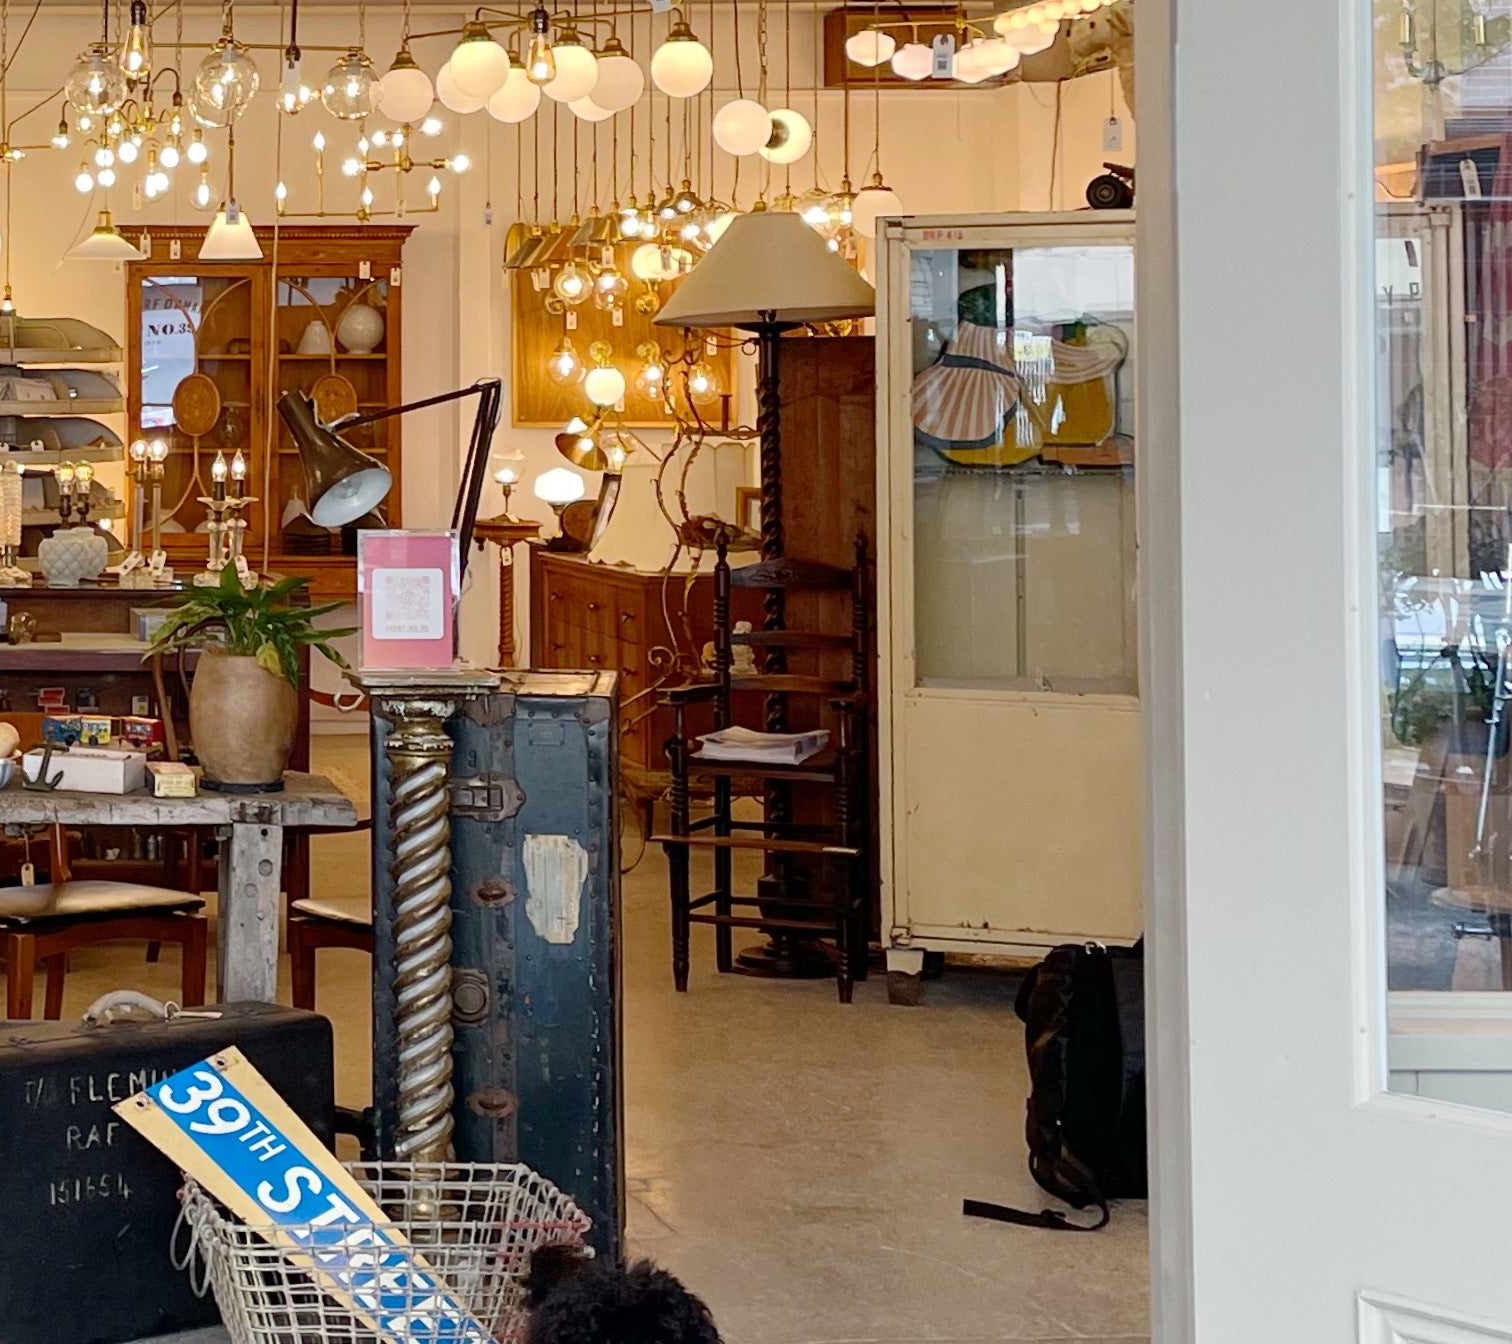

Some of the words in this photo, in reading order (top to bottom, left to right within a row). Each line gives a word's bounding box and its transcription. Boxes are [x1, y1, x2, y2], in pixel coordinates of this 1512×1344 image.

[69, 1067, 176, 1105] FLEMI
[66, 1122, 120, 1149] RAF
[159, 1070, 286, 1163] 39TH
